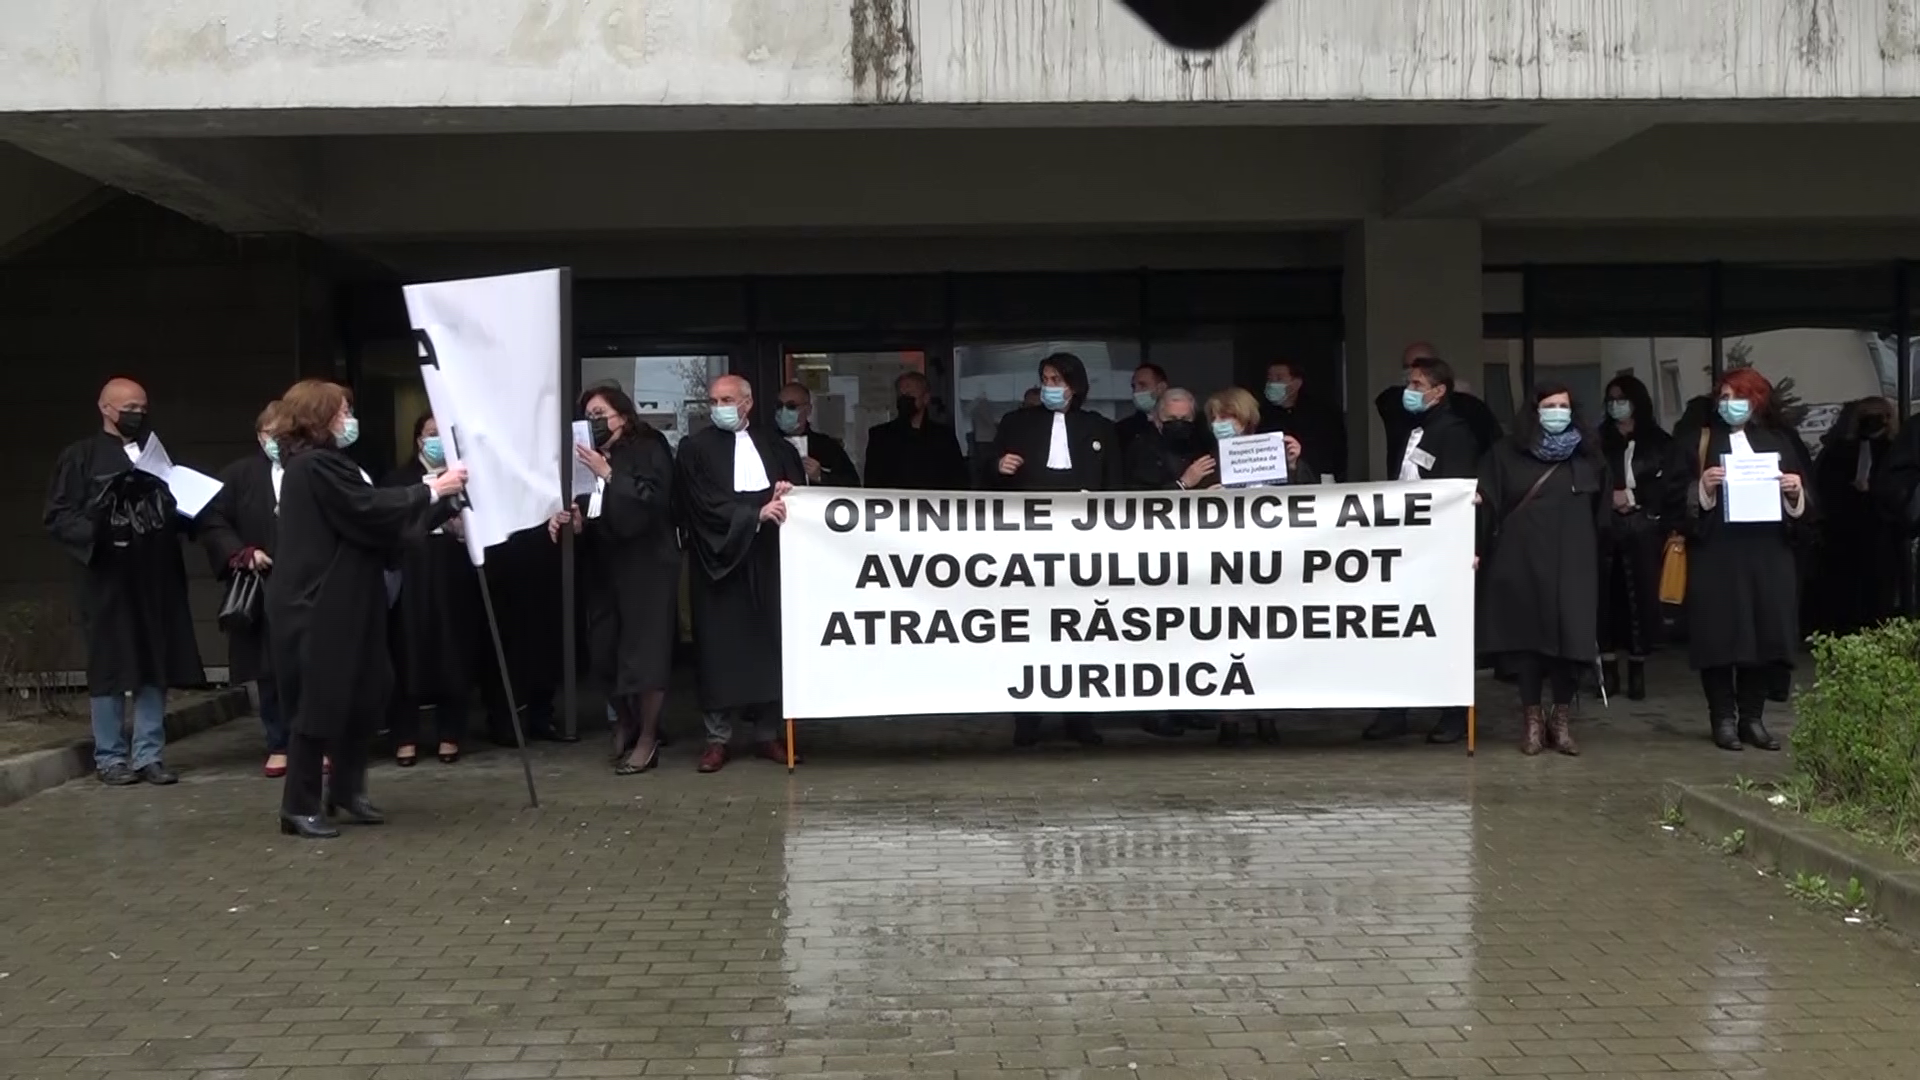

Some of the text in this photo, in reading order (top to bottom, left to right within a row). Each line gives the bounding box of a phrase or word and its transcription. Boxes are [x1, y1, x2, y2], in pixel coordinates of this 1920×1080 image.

[1229, 446, 1278, 456] Respect pentru
[1231, 457, 1267, 465] autoritatea
[1251, 465, 1275, 474] judecat
[825, 493, 1432, 533] OPINIILE JURIDICE ALE
[855, 548, 1402, 589] AVOCATULUI NU POT
[820, 599, 1437, 646] ATRAGE RĂSPUNDEREA
[1007, 652, 1255, 699] JURIDICĂ
